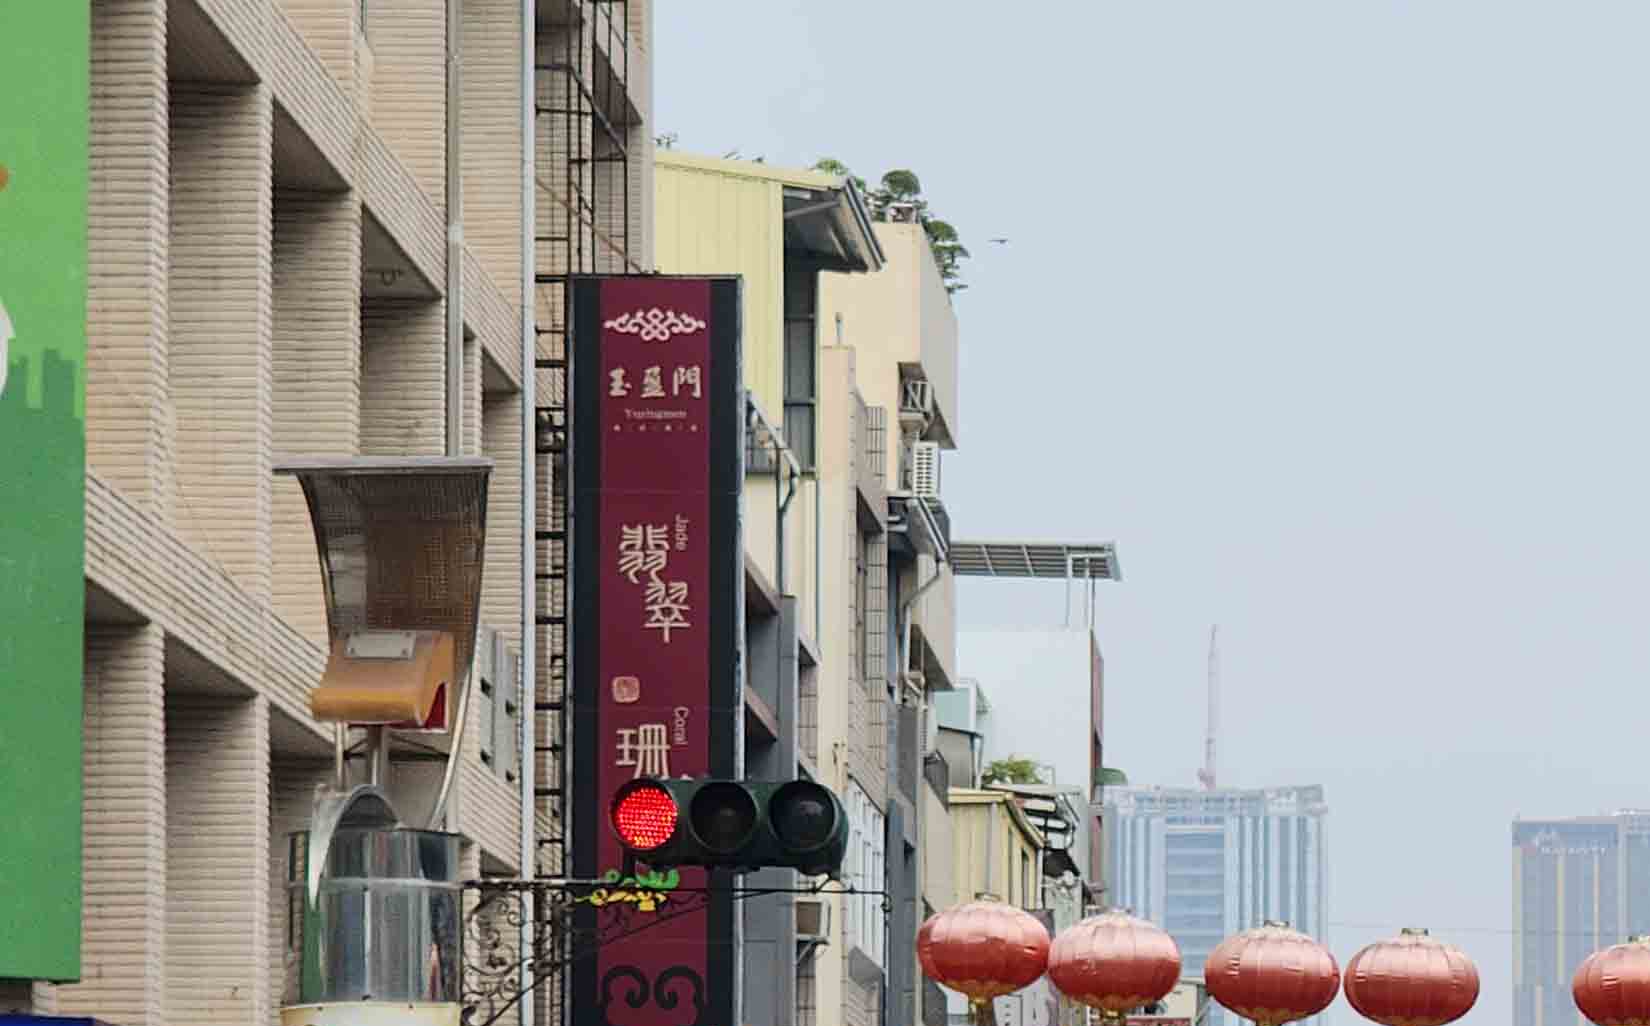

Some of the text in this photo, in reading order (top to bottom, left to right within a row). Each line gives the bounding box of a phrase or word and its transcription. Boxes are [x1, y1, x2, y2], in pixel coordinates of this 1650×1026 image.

[675, 513, 692, 551] Jade
[618, 524, 692, 643] 翡翠
[673, 706, 689, 745] Coral
